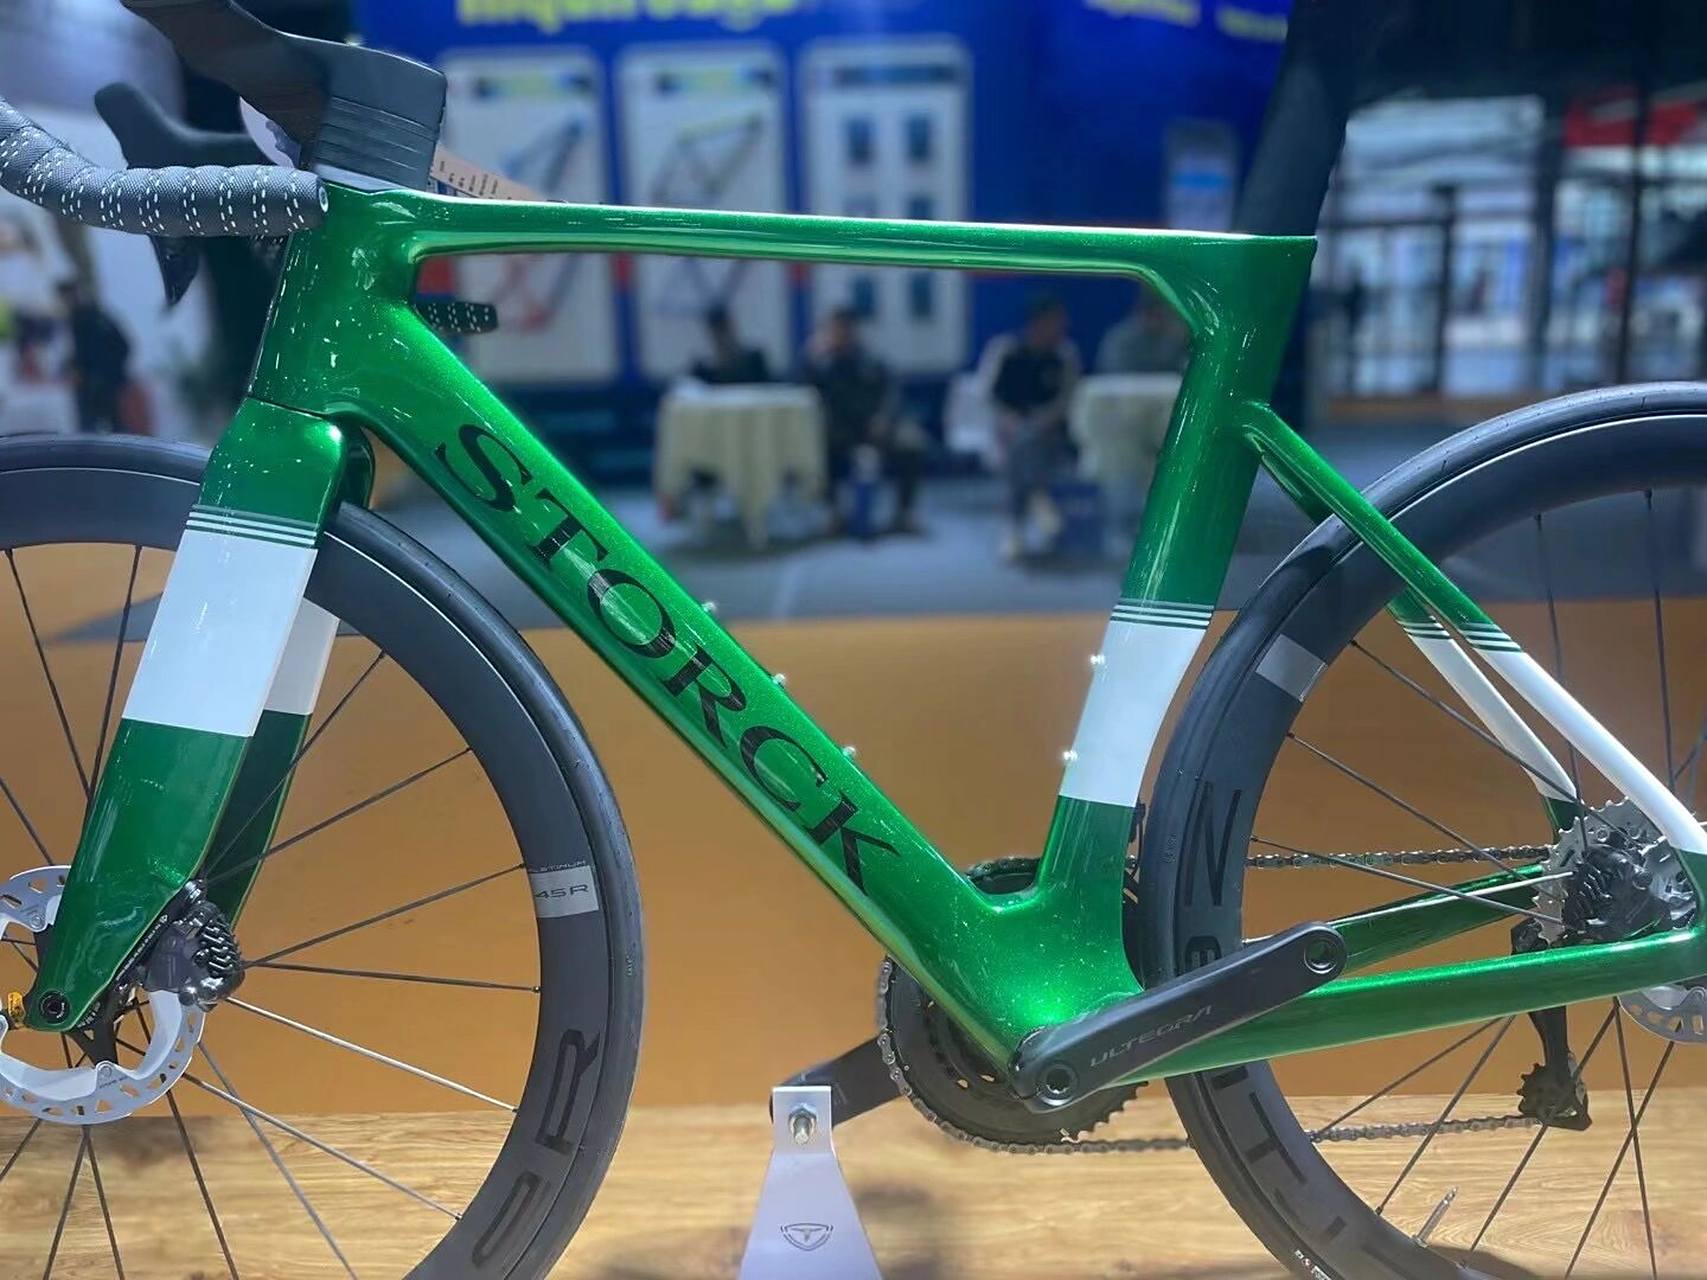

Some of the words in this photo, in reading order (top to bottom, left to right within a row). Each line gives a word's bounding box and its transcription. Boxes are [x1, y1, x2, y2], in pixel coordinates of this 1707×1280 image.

[433, 423, 900, 897] STORCK
[535, 883, 589, 899] 45R
[1090, 1004, 1212, 1067] ULTEGRA
